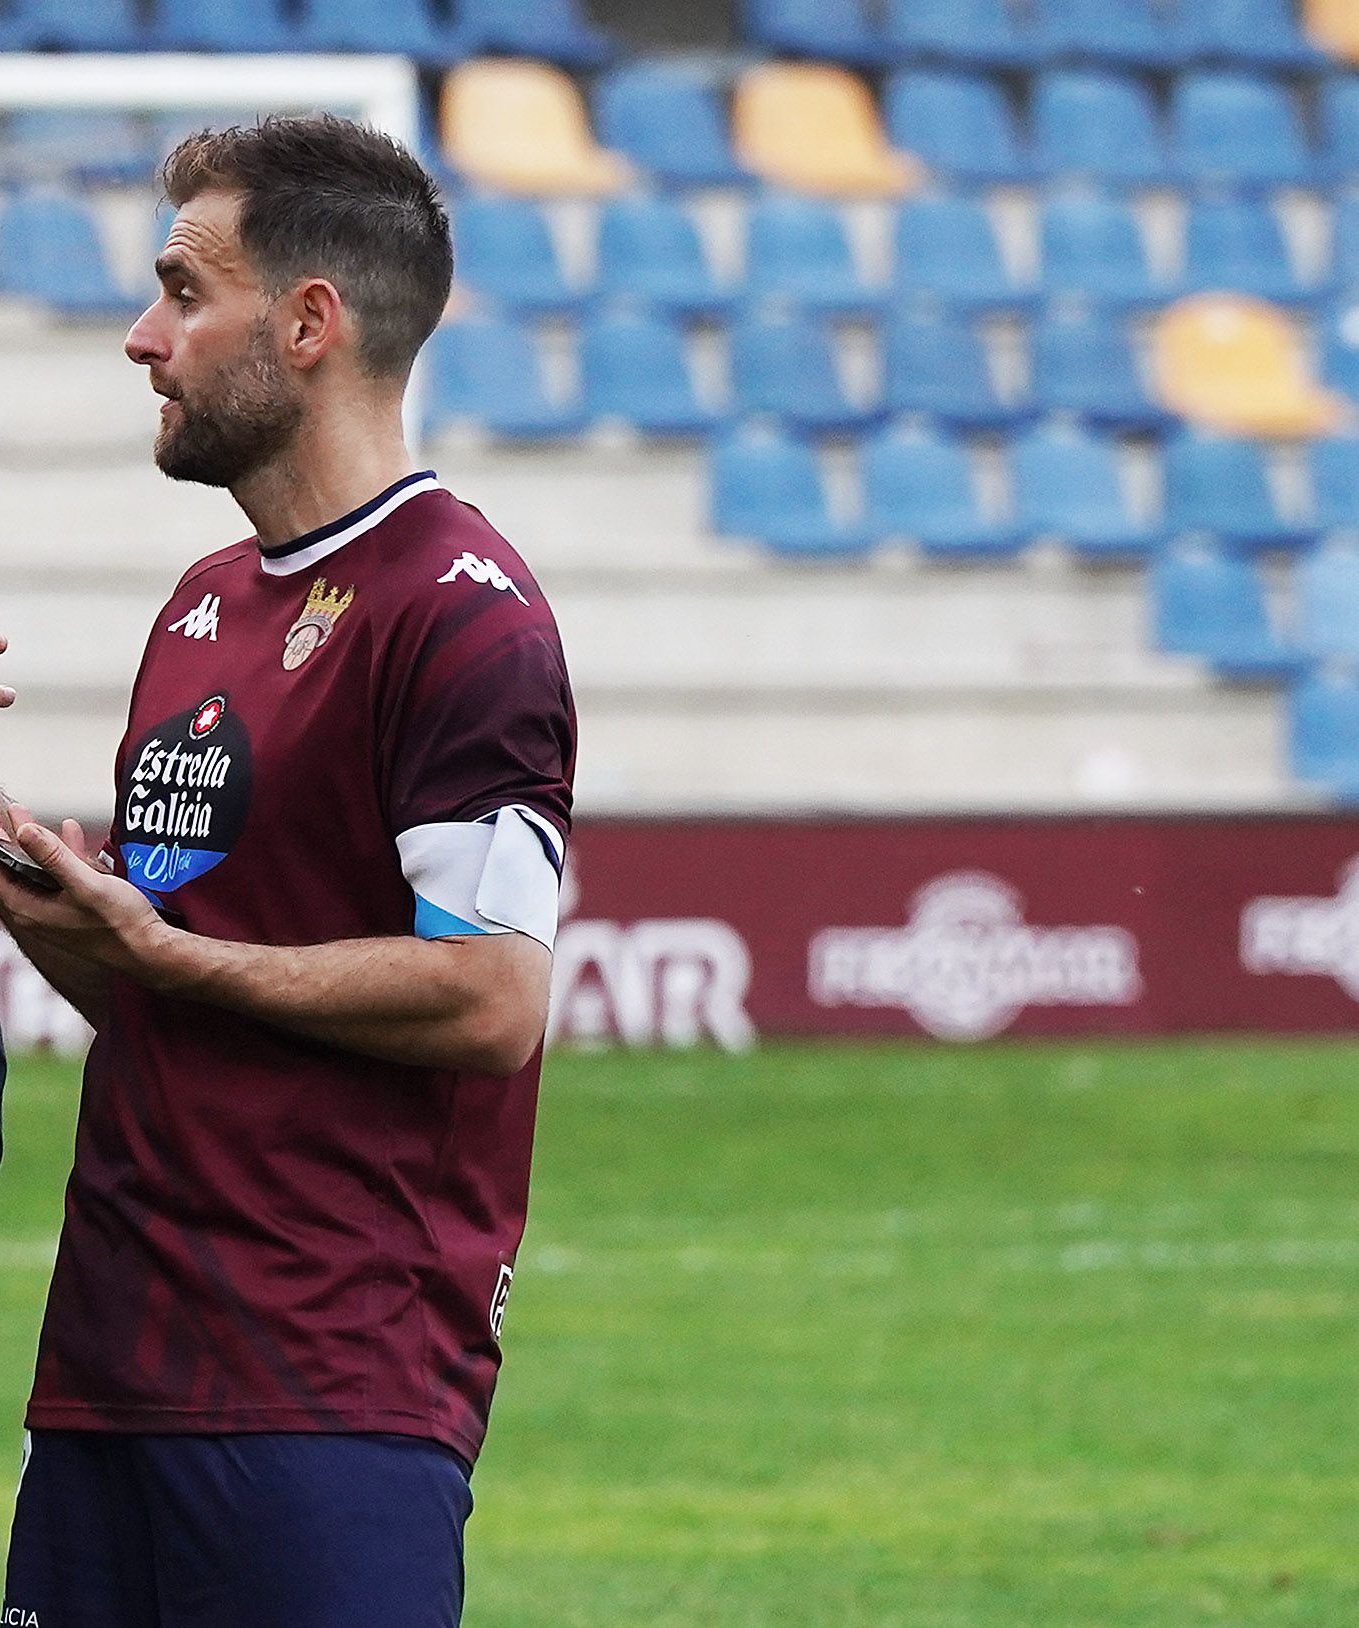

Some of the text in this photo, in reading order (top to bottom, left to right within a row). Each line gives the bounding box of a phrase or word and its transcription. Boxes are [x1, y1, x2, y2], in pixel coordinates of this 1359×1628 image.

[130, 738, 232, 788] Estrella
[126, 784, 212, 838] Galicia
[143, 842, 180, 883] 0,0
